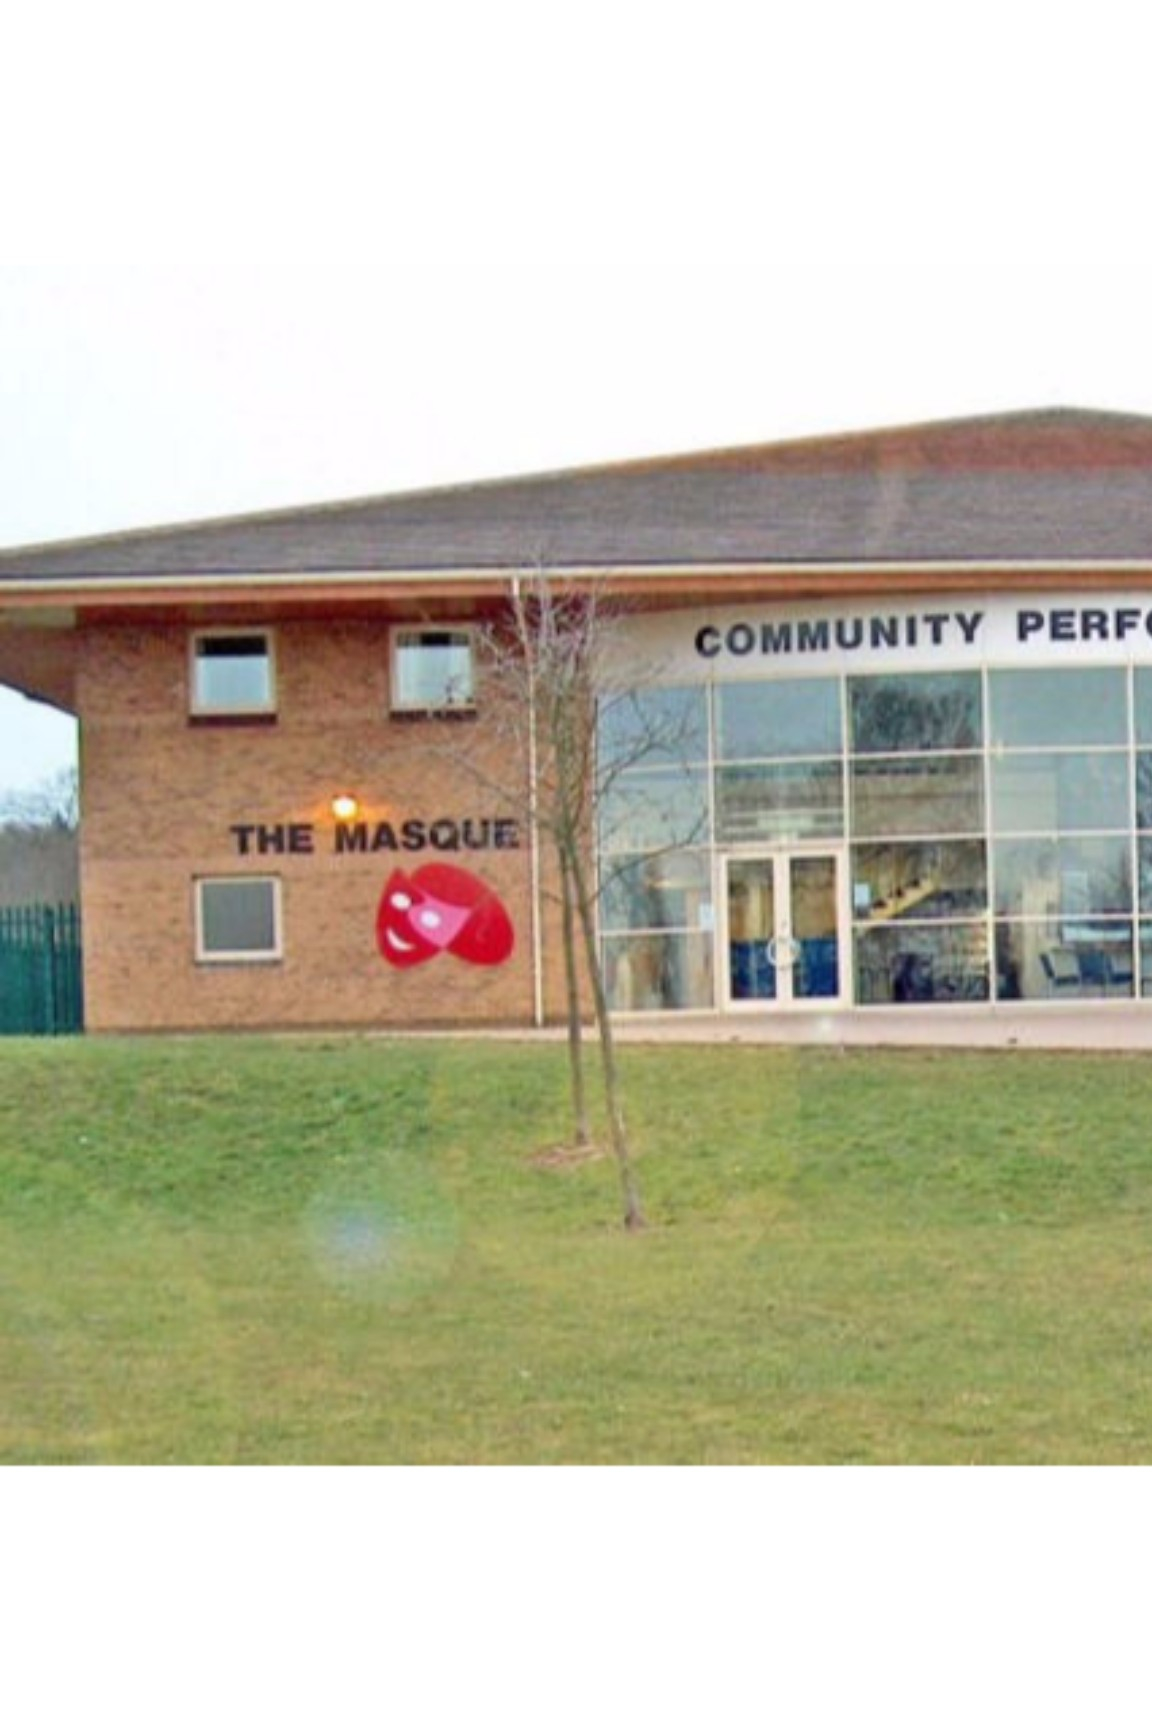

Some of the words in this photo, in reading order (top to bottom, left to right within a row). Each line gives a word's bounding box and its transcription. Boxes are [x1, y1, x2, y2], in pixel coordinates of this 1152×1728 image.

[695, 611, 984, 658] COMMUNITY
[231, 824, 314, 854] THE
[334, 819, 520, 853] MASQUE
